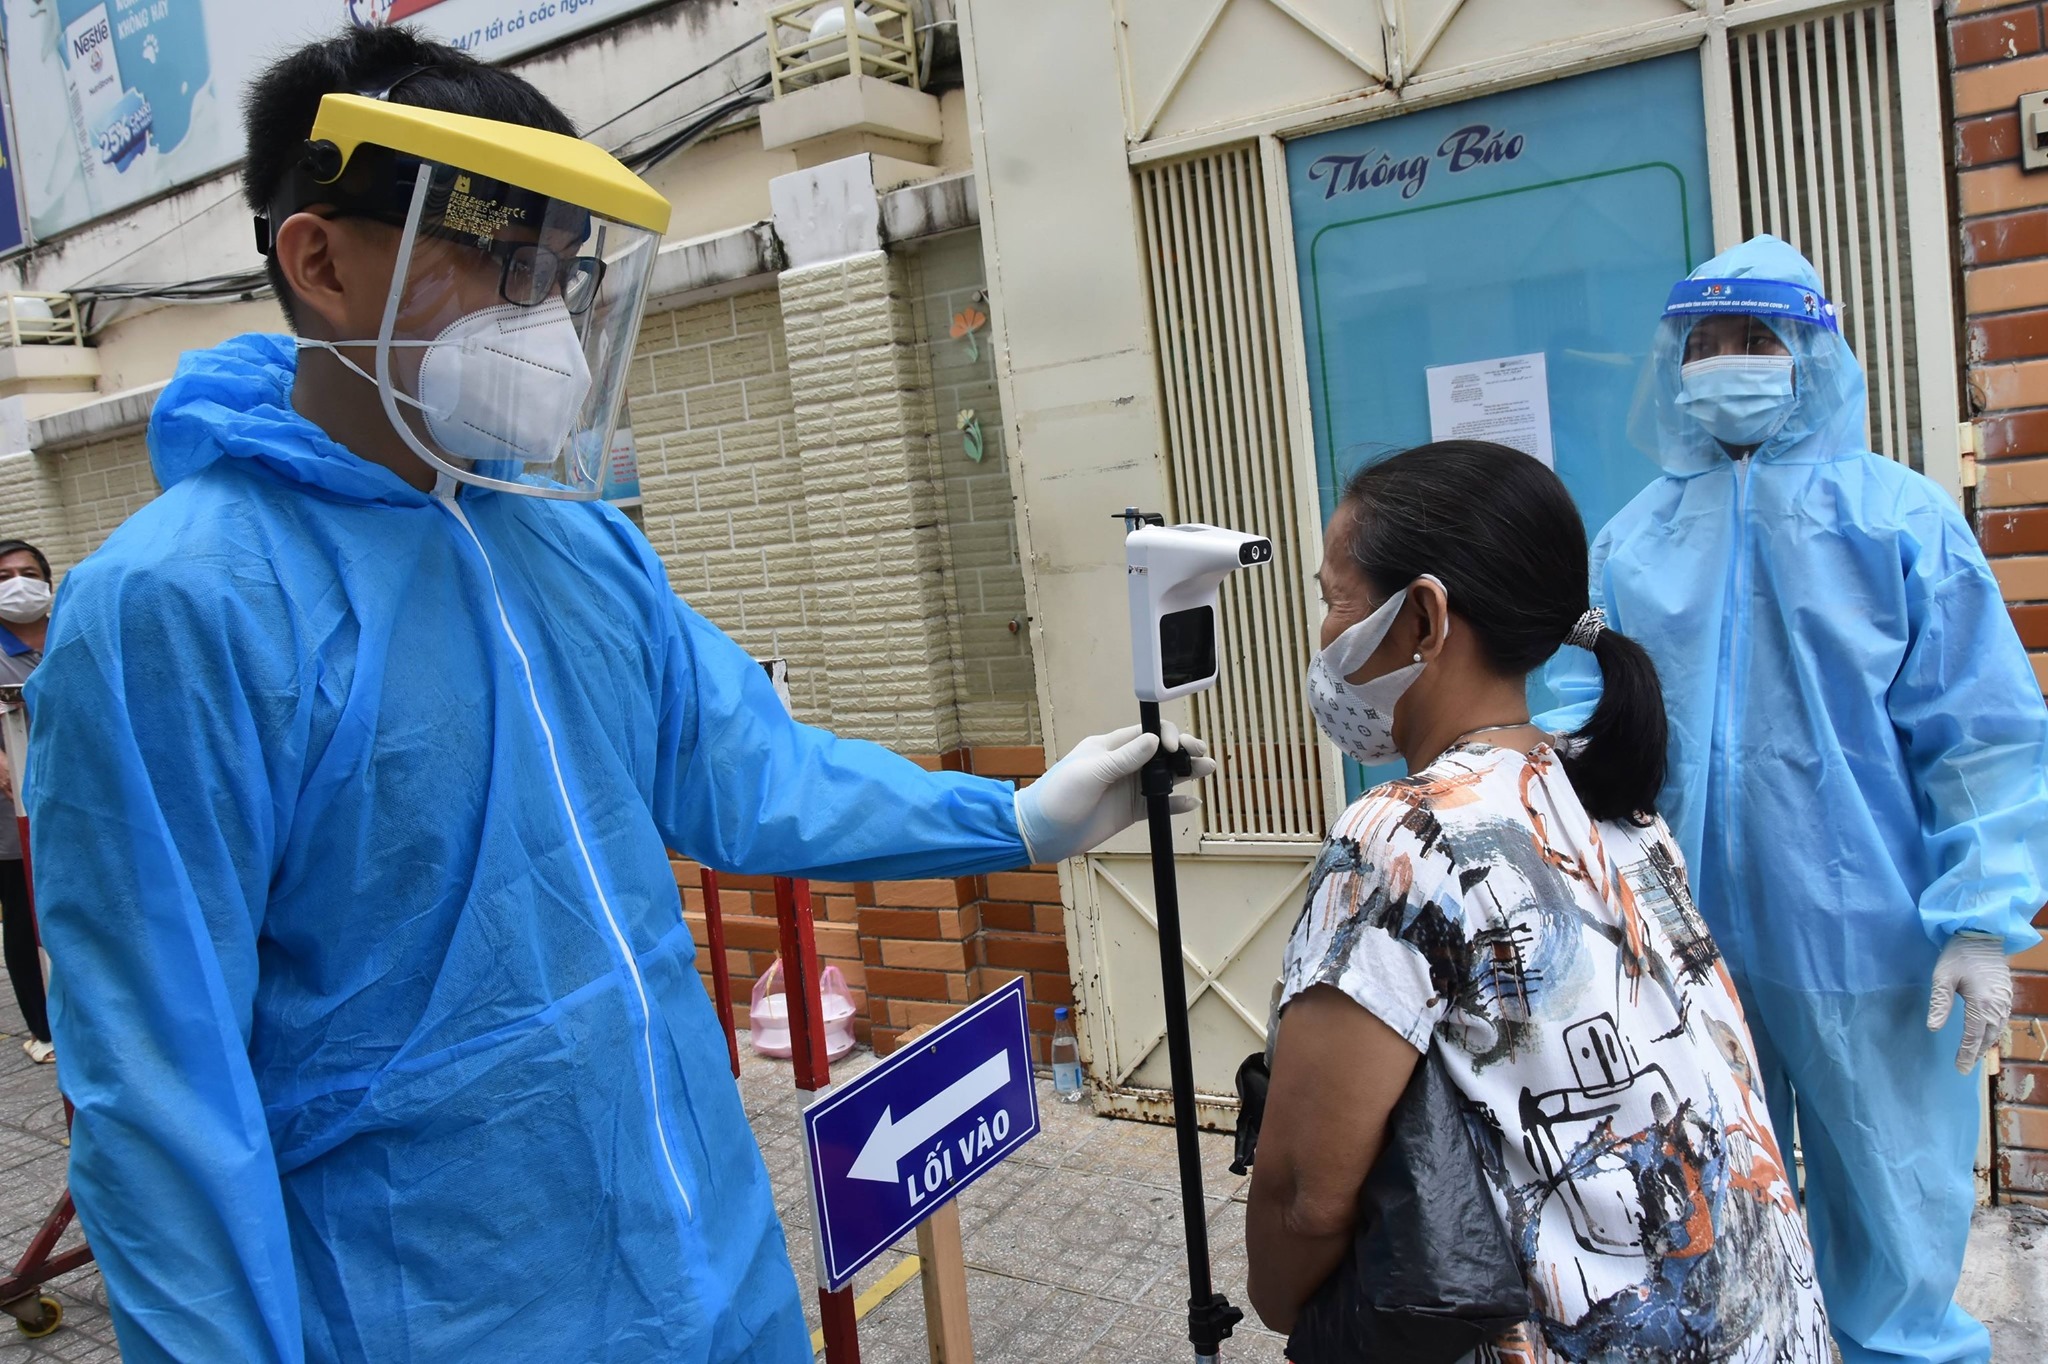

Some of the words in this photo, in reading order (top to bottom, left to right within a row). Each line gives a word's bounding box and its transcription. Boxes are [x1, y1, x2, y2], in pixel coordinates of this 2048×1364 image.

[485, 18, 503, 42] tất
[507, 10, 525, 33] cả
[529, 2, 556, 24] các
[100, 114, 131, 163] 25%
[1308, 147, 1430, 200] Thông
[1437, 124, 1524, 172] Báo
[1770, 302, 1790, 310] COVID-19
[907, 1140, 953, 1208] LỐI
[958, 1109, 1010, 1166] VÀO
